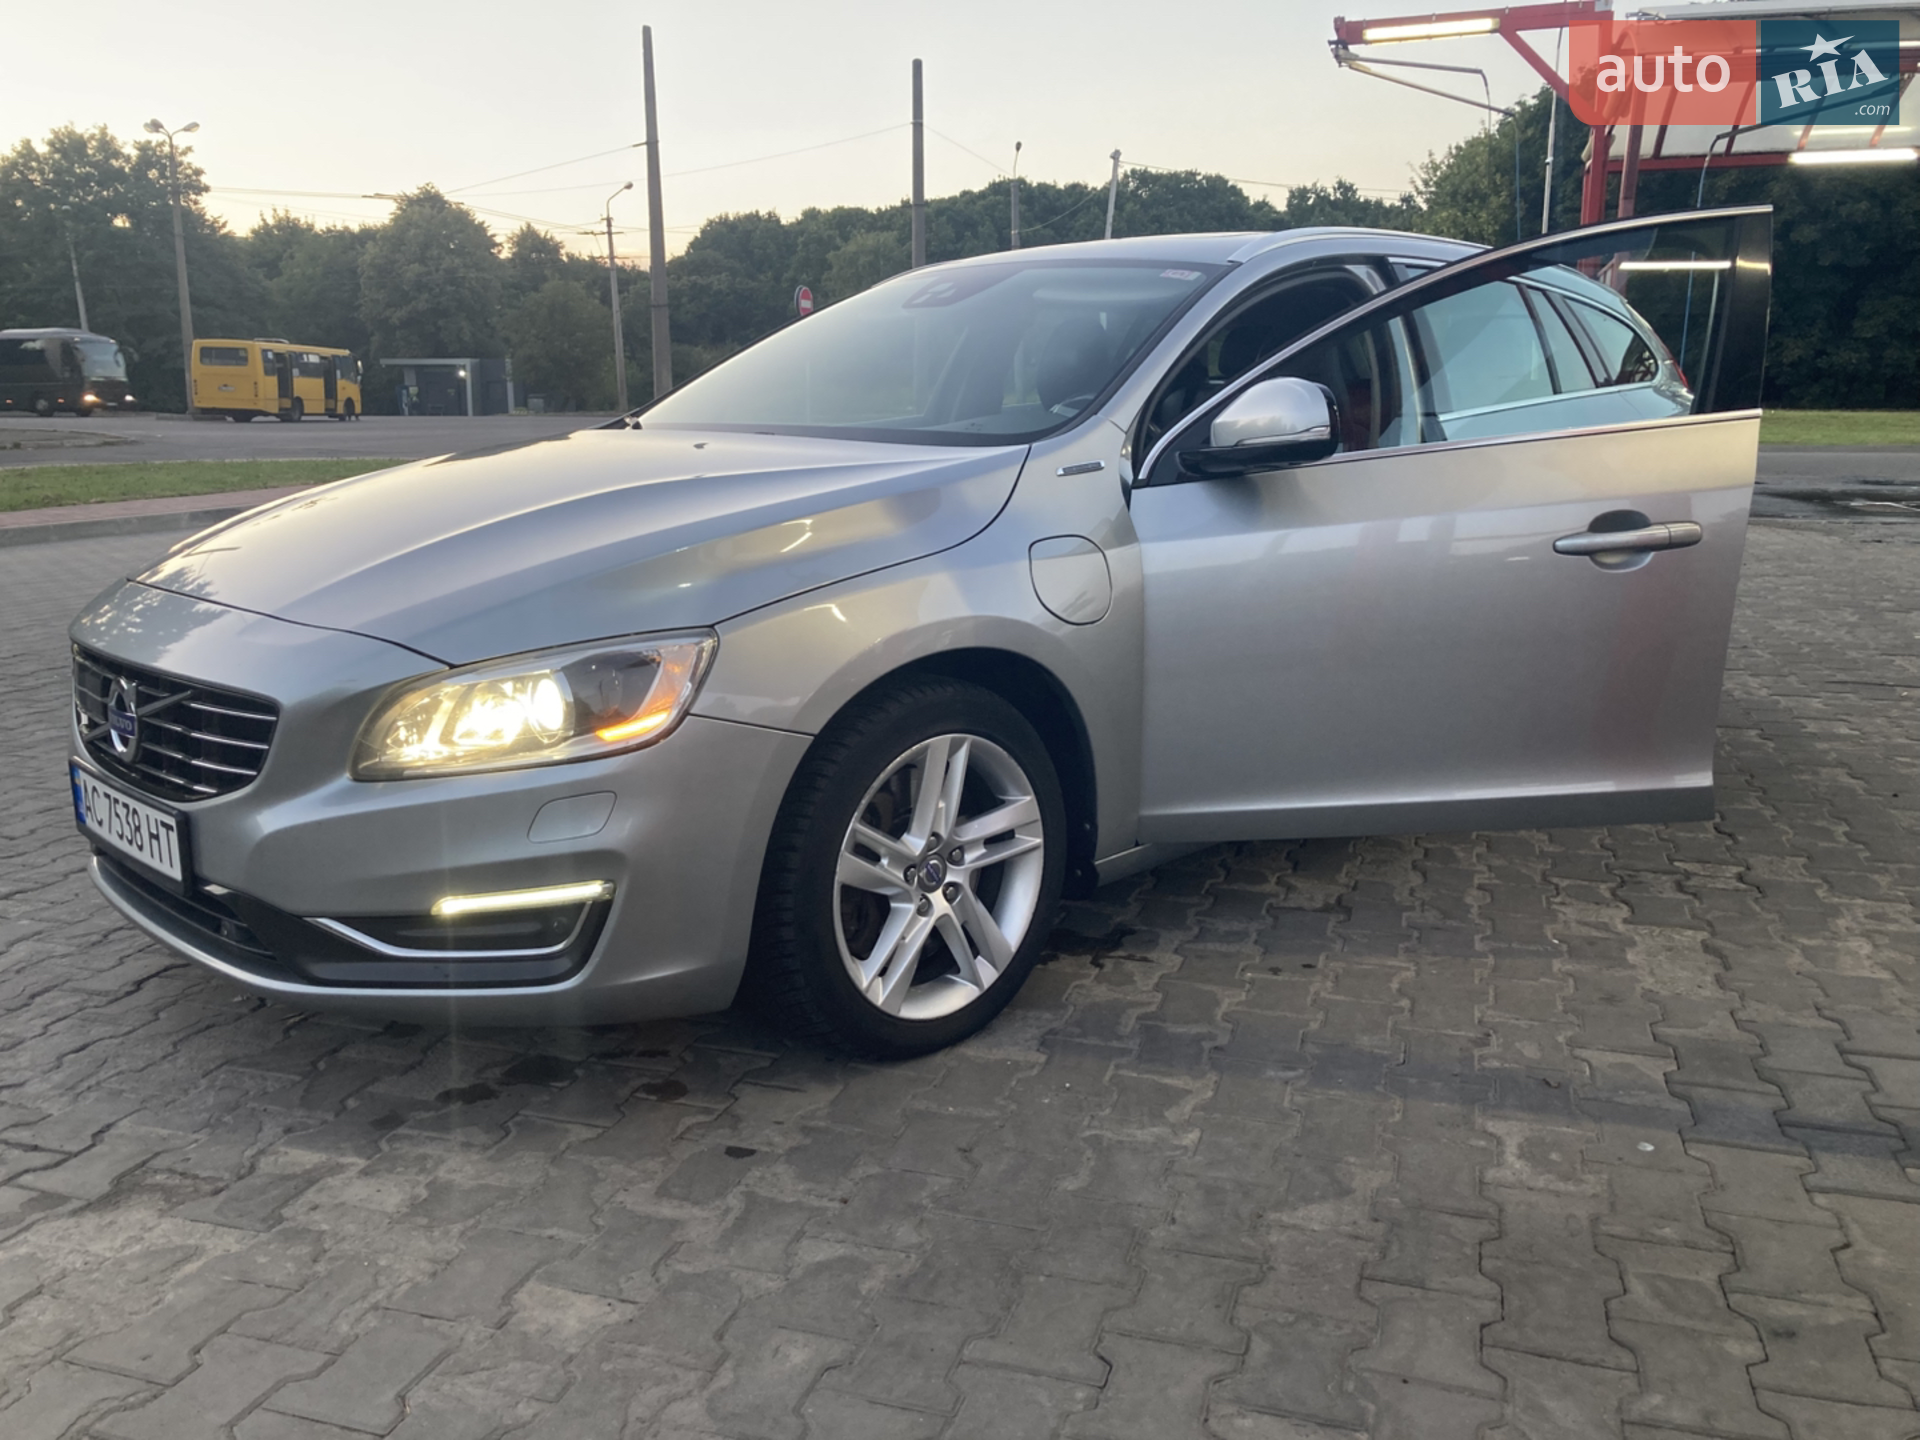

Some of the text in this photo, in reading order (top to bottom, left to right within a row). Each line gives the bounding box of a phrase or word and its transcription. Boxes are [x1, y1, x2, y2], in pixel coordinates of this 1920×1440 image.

[83, 779, 175, 869] AC 7538 HT
